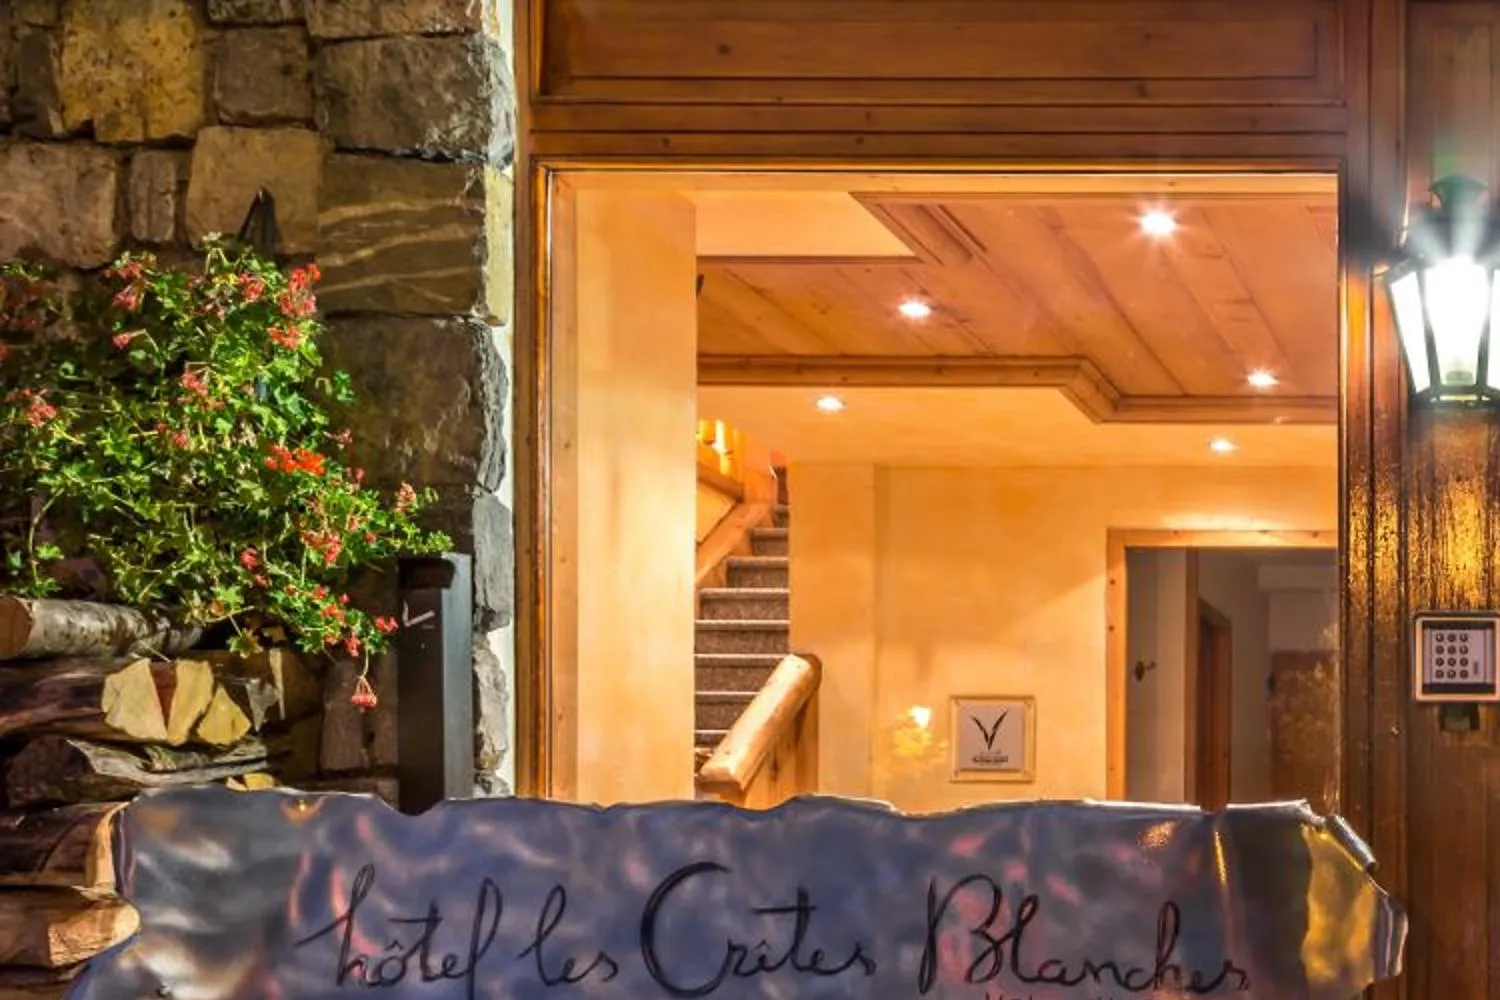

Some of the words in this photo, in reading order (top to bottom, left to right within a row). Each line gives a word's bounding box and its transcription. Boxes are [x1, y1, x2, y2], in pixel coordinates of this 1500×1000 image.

[516, 884, 620, 988] les
[640, 861, 875, 997] Crêtes
[918, 873, 1251, 995] Blanches
